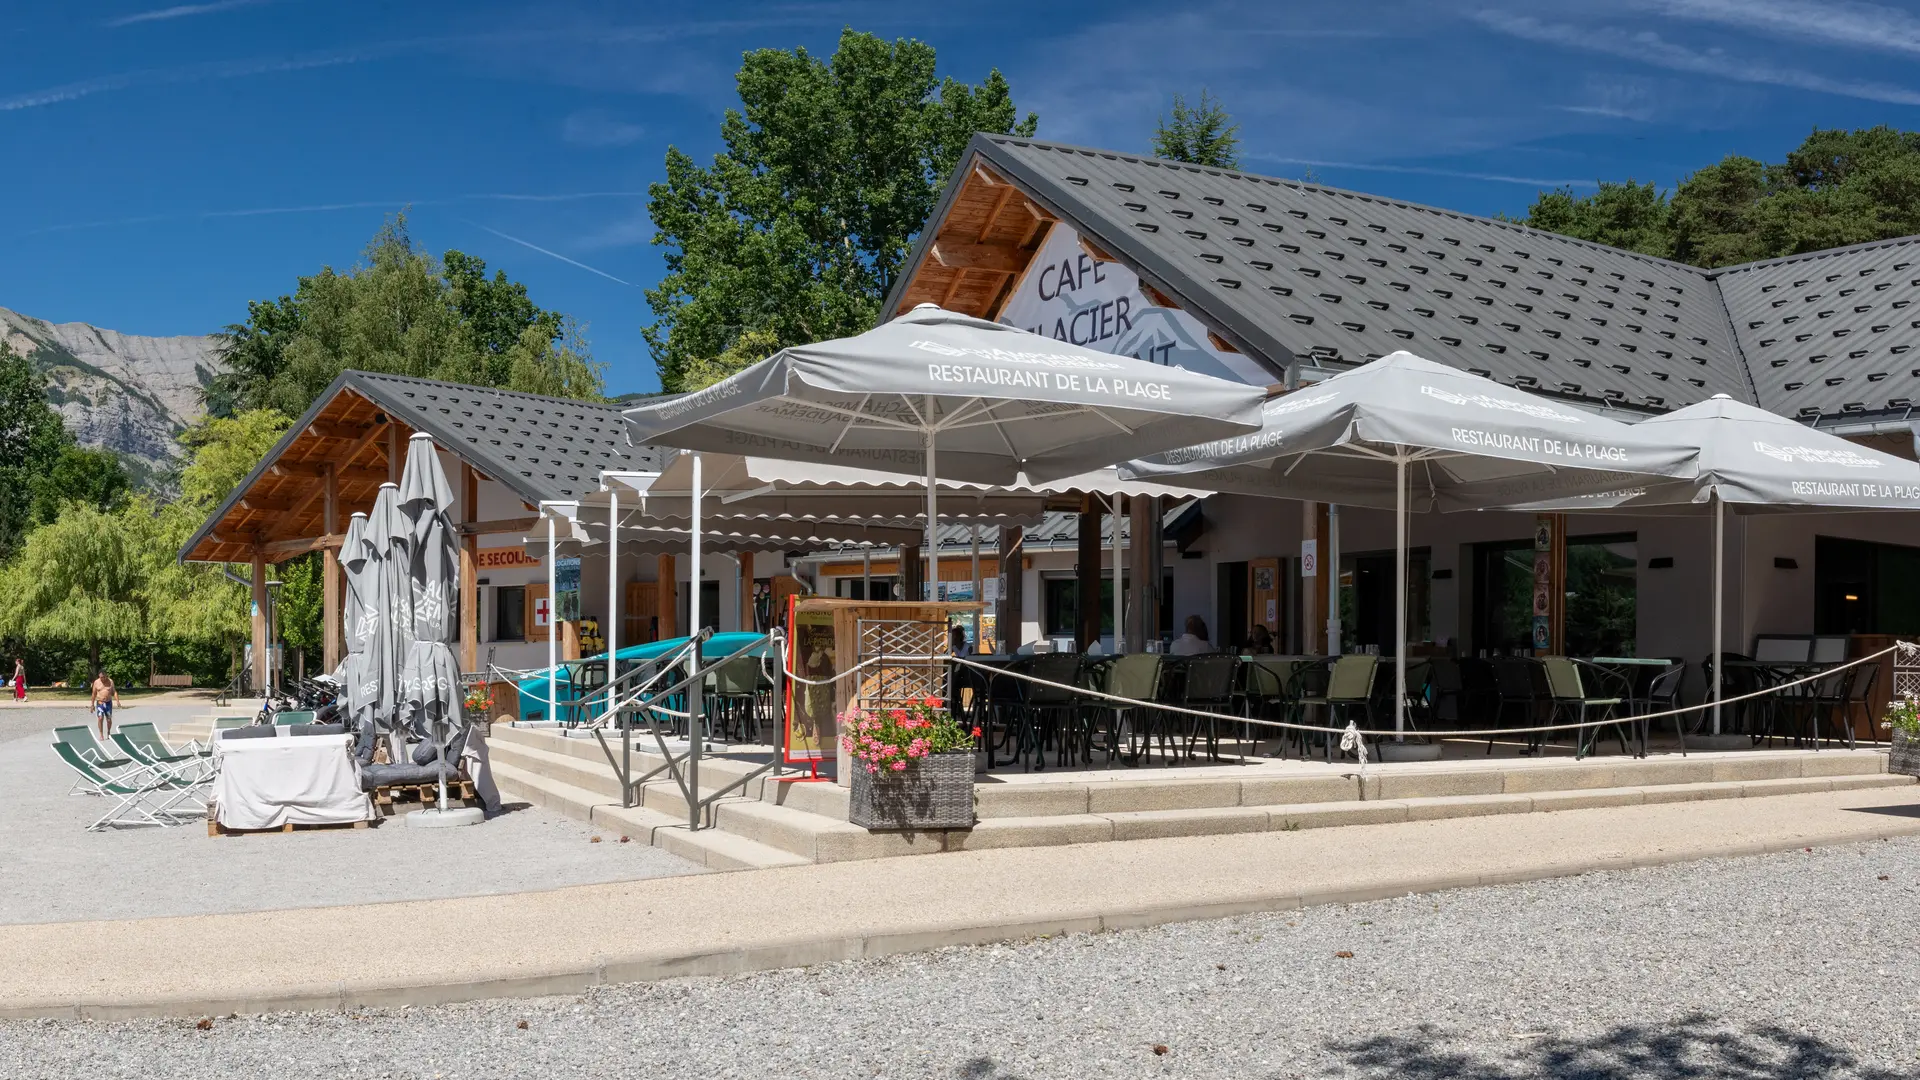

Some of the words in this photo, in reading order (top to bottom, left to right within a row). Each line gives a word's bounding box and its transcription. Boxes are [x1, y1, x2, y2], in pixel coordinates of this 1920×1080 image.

[1027, 295, 1132, 346] ACIER
[714, 377, 742, 401] PLAGE
[928, 364, 1049, 388] RESTAURANT
[1056, 373, 1081, 391] DE
[1085, 377, 1109, 393] LA
[1113, 379, 1172, 400] PLAGE
[1164, 441, 1218, 465] RESTAURANT
[1220, 440, 1234, 455] DE
[1236, 437, 1249, 453] LA
[1250, 430, 1283, 449] PLAGE
[1452, 427, 1540, 453] RESTAURANT
[1543, 439, 1562, 456] DE
[1565, 442, 1583, 458] LA
[1585, 444, 1628, 461] PLAGE
[1792, 481, 1859, 496] RESTAURANT
[1863, 484, 1877, 498] DE
[1879, 485, 1892, 498] LA
[1894, 486, 1920, 500] PLAG
[487, 550, 540, 566] SECOUR
